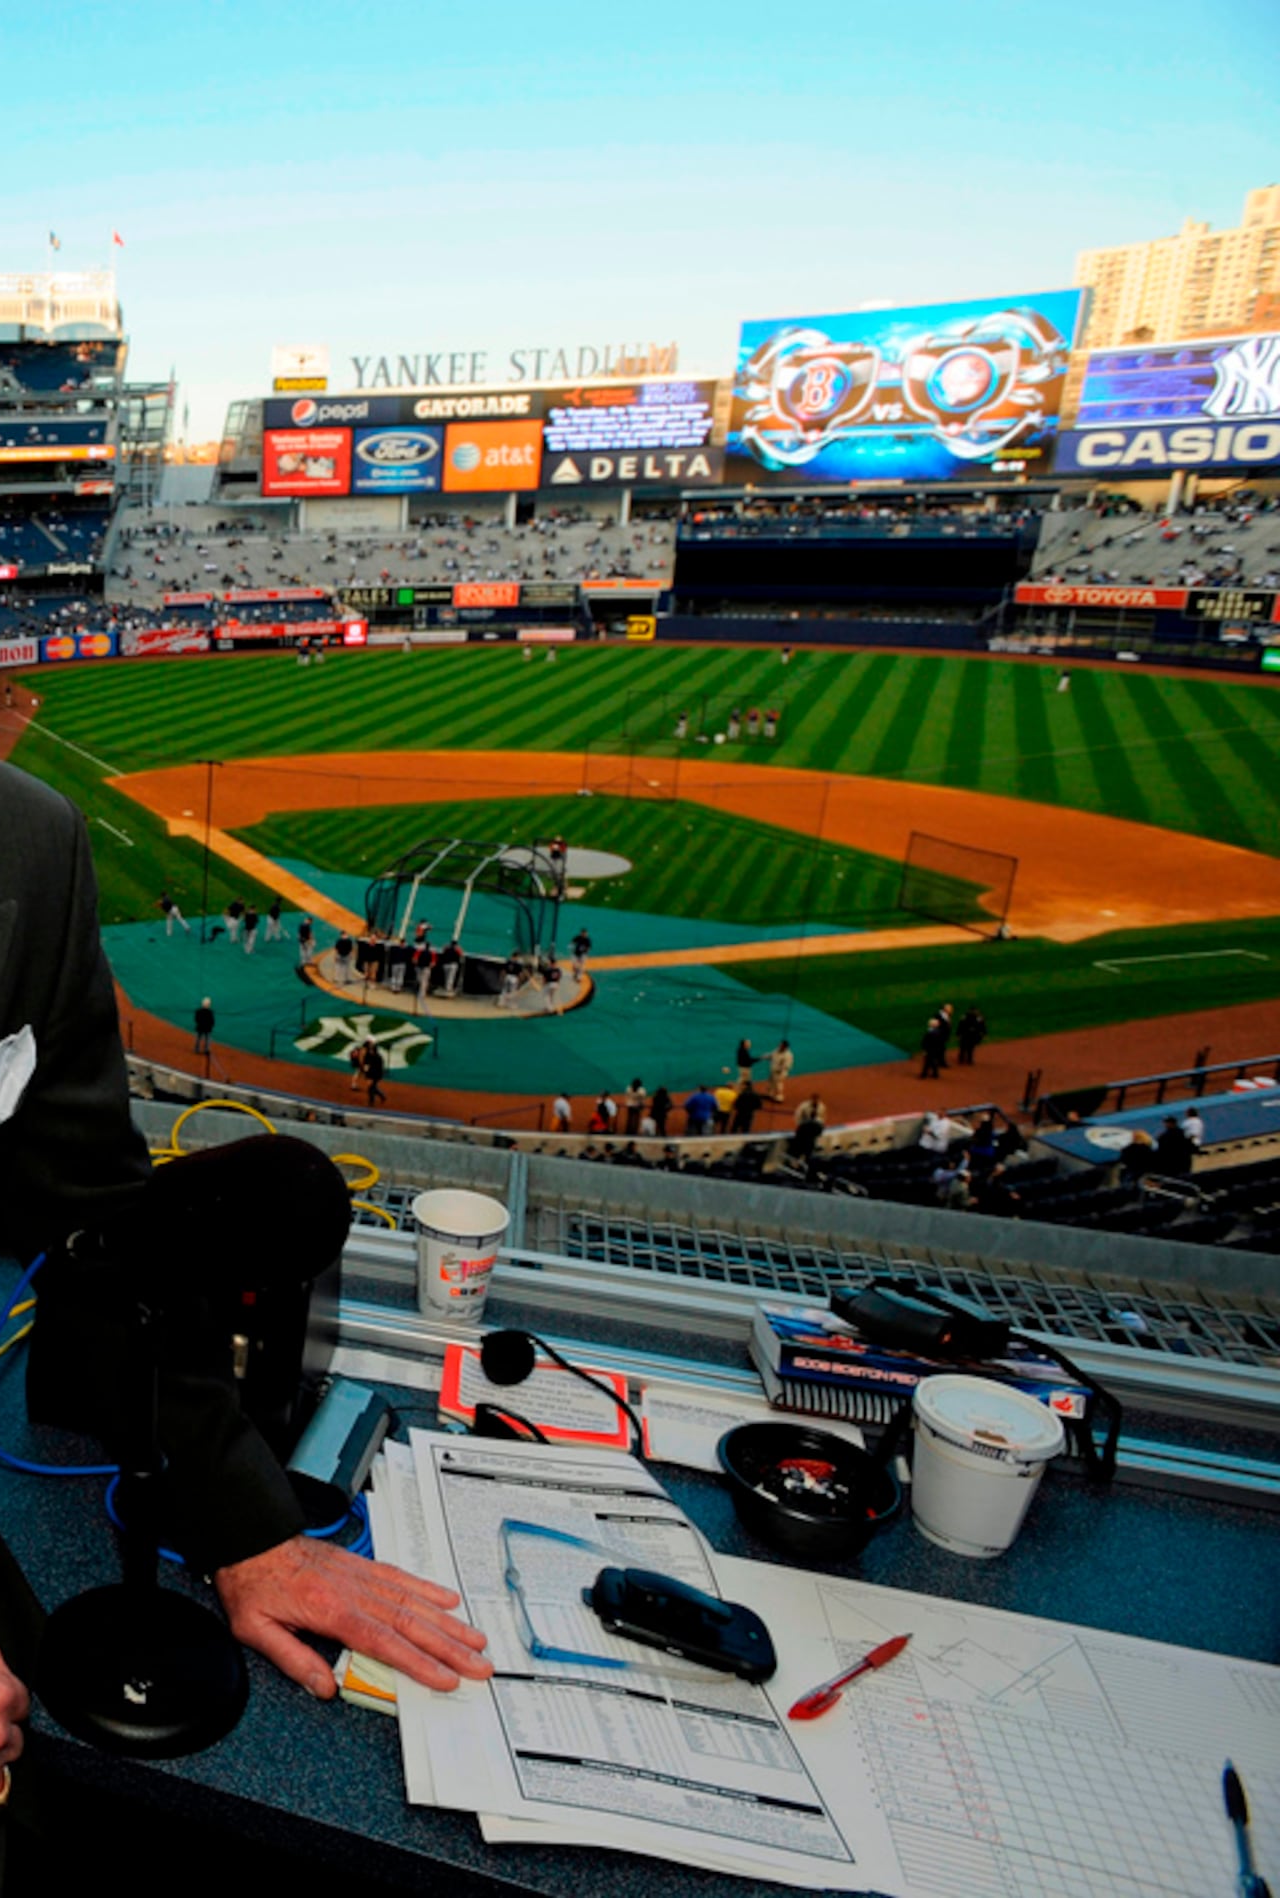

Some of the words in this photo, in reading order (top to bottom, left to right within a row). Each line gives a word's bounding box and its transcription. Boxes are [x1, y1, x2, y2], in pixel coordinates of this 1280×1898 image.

[351, 351, 487, 388] YANKEE
[507, 342, 678, 383] STADIUM
[320, 402, 368, 421] pepsi
[414, 395, 531, 418] GATORADE
[374, 439, 420, 459] Ford
[485, 442, 535, 466] at&t
[1076, 424, 1280, 467] CASIO
[590, 454, 711, 480] DELTA
[1076, 588, 1156, 606] TOYOTA
